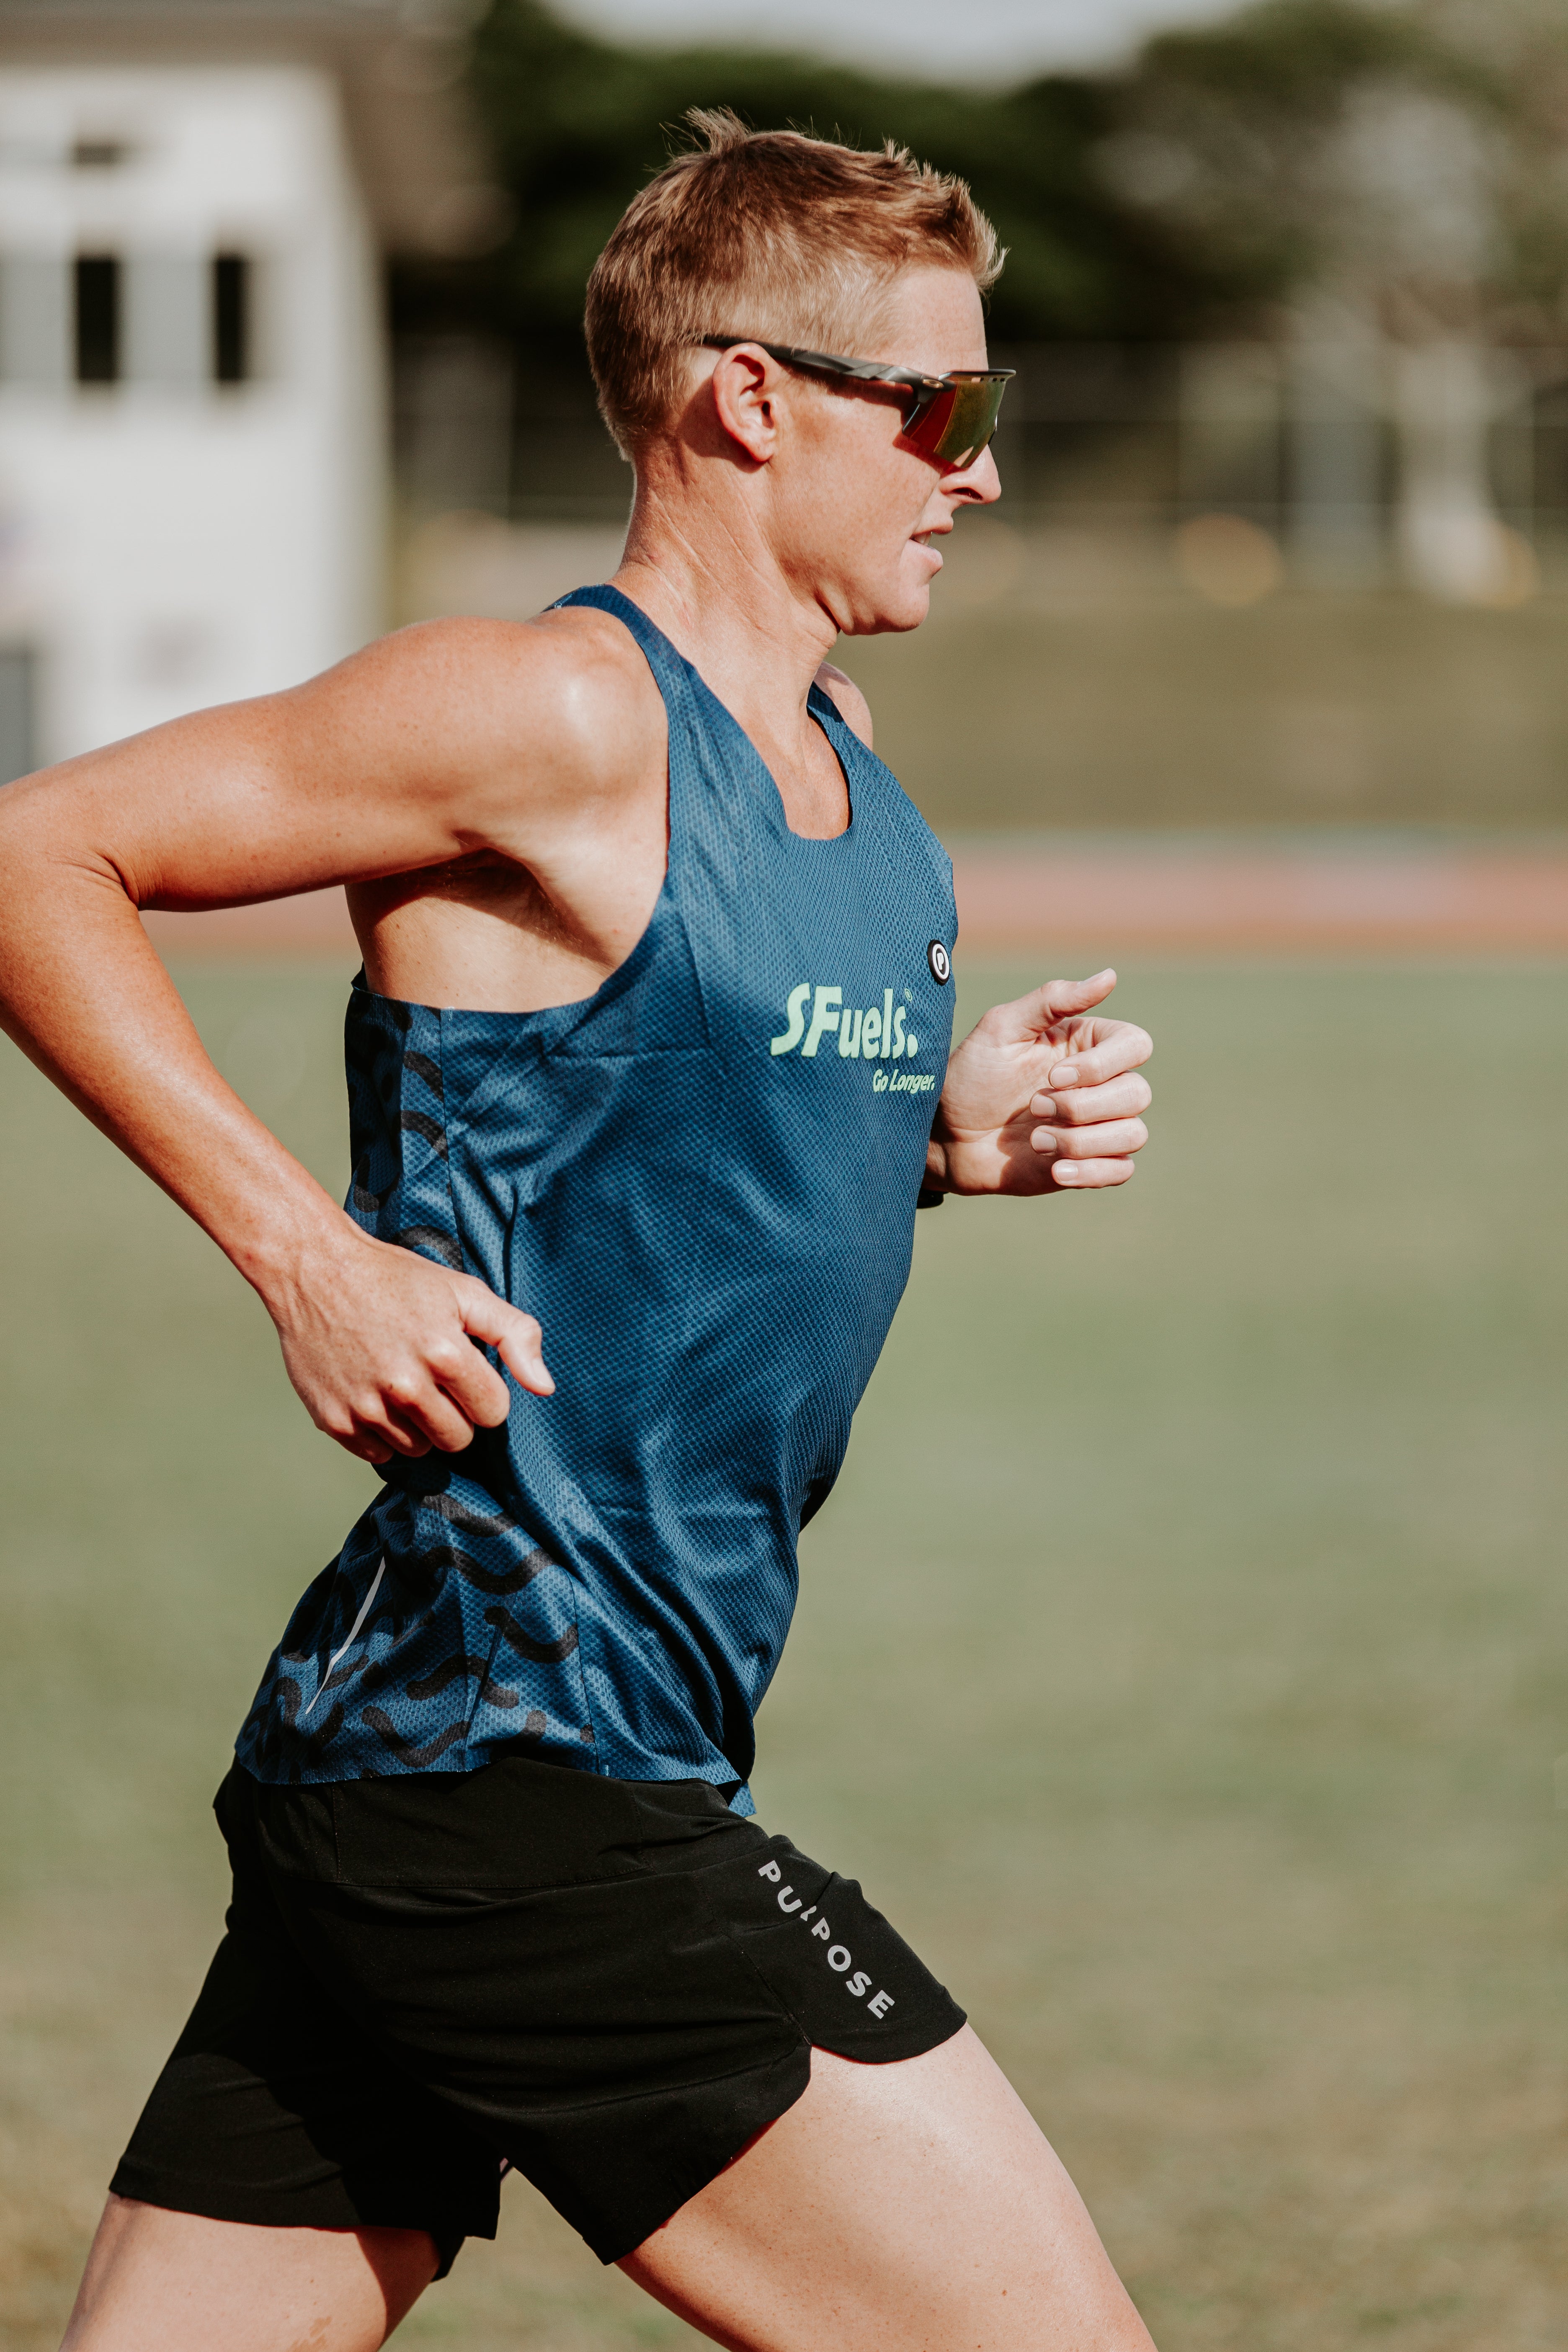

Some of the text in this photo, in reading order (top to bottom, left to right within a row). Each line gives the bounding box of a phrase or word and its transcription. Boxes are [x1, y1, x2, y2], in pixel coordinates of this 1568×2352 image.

[771, 982, 918, 1059] SFuels.
[873, 1068, 935, 1094] Go Longer.
